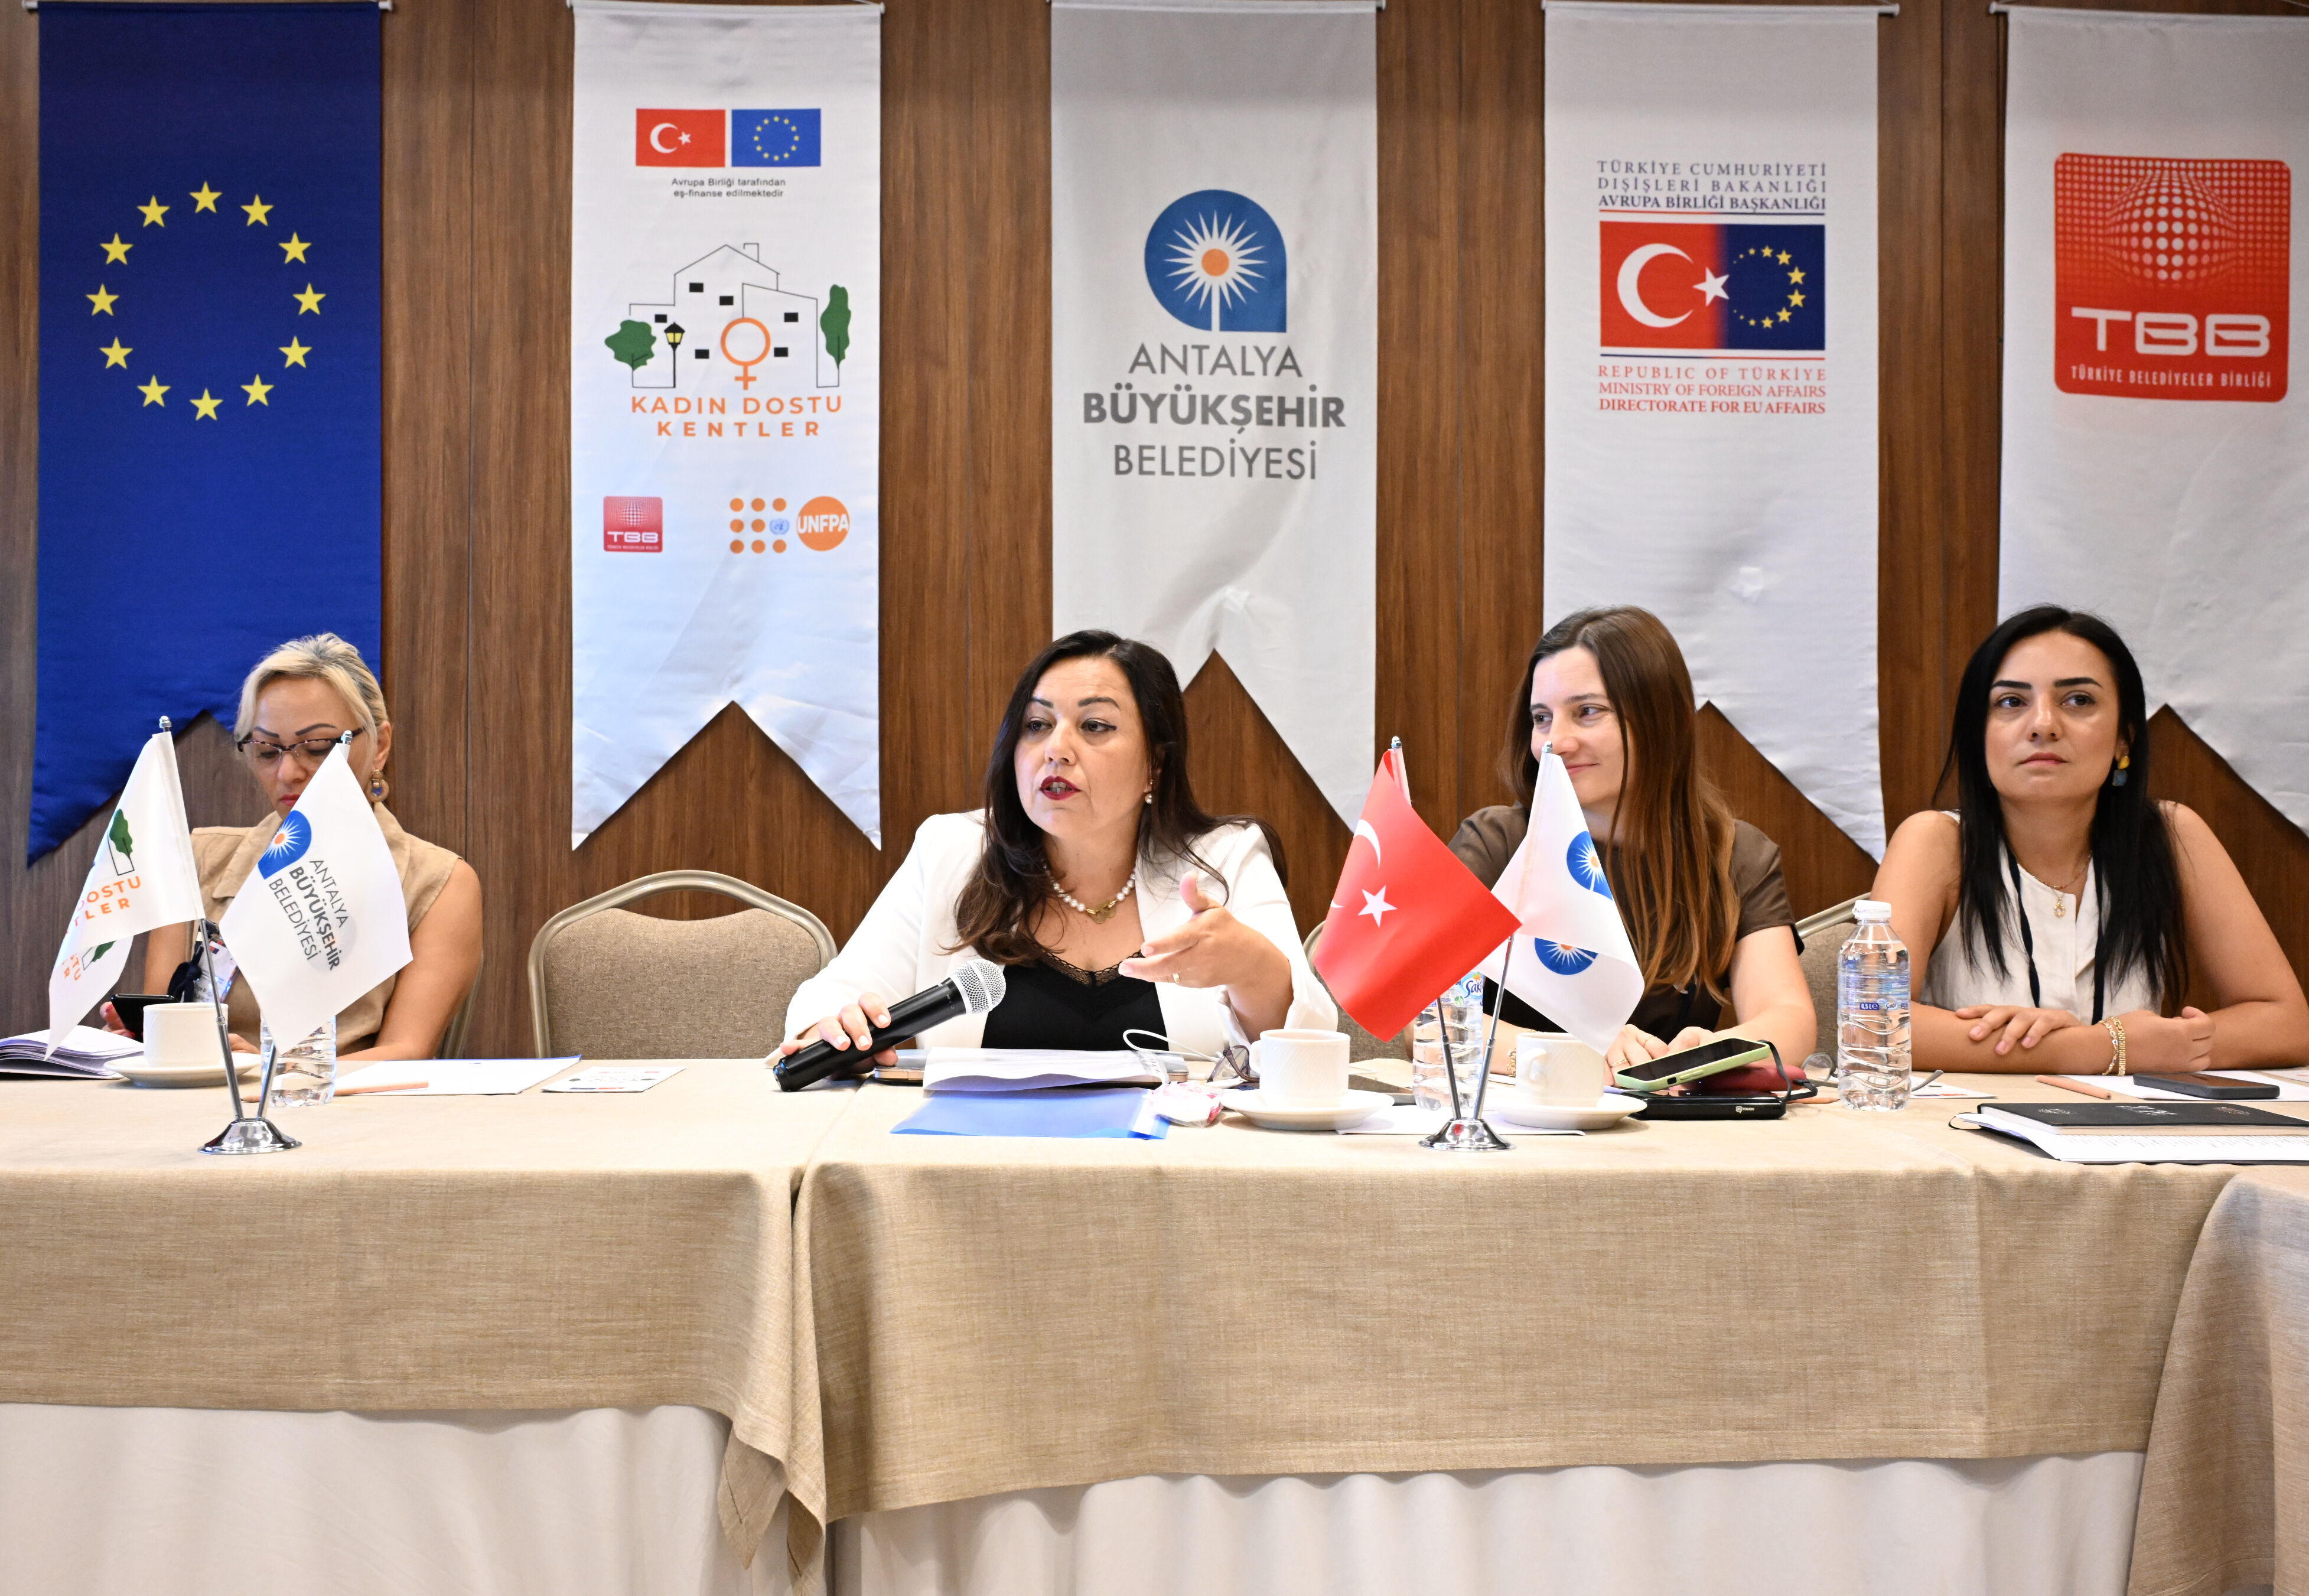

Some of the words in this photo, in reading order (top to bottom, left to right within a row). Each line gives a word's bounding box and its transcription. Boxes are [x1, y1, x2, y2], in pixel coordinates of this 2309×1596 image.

[1597, 159, 1682, 175] TÜRKİYE
[1689, 162, 1826, 177] CUMHURİYETİ
[671, 177, 705, 188] Avrupa
[708, 177, 735, 188] Birliği
[738, 177, 786, 187] tarafından
[1597, 177, 1699, 193] DIŞİŞLERİ
[1711, 178, 1826, 194] BAKANLIĞI
[673, 189, 723, 198] eş-finanse
[726, 189, 784, 197] edilmektedir
[1598, 195, 1661, 208] AVRUPA
[1665, 194, 1724, 209] BİRLİĞİ
[1729, 197, 1826, 213] BAŞKANLIĞI
[2071, 307, 2271, 358] TBB
[1127, 341, 1304, 378] ANTALYA
[1597, 365, 1696, 379] REPUBLIC
[1705, 367, 1730, 380] OF
[1737, 367, 1826, 381] TÜRKİYE
[2070, 364, 2123, 383] TÜRKİYE
[2129, 369, 2213, 387] BELEDİYELER
[2220, 370, 2271, 388] BİRLİĞİ
[1598, 382, 1672, 396] MINISTRY
[1674, 383, 1695, 396] OF
[1698, 385, 1763, 397] FOREIGN
[1766, 385, 1826, 398] AFFAIRS
[631, 396, 727, 414] KADIN
[742, 395, 842, 414] DOSTU
[1082, 381, 1347, 435] BÜYÜKŞEHİR
[1598, 398, 1708, 412] DIRECTORATE
[1711, 400, 1740, 413] FOR
[1743, 401, 1764, 413] EU
[1764, 402, 1826, 415] AFFAIRS
[657, 421, 819, 437] KENTLER
[1113, 437, 1317, 480] BELEDİYESİ
[797, 513, 849, 535] UNFPA
[607, 531, 659, 543] TBB
[309, 860, 349, 928] ANTALYA
[269, 878, 321, 960] BELEDİYESİ
[289, 866, 342, 971] BÜYÜKŞEHİR
[1464, 979, 1483, 998] Sak
